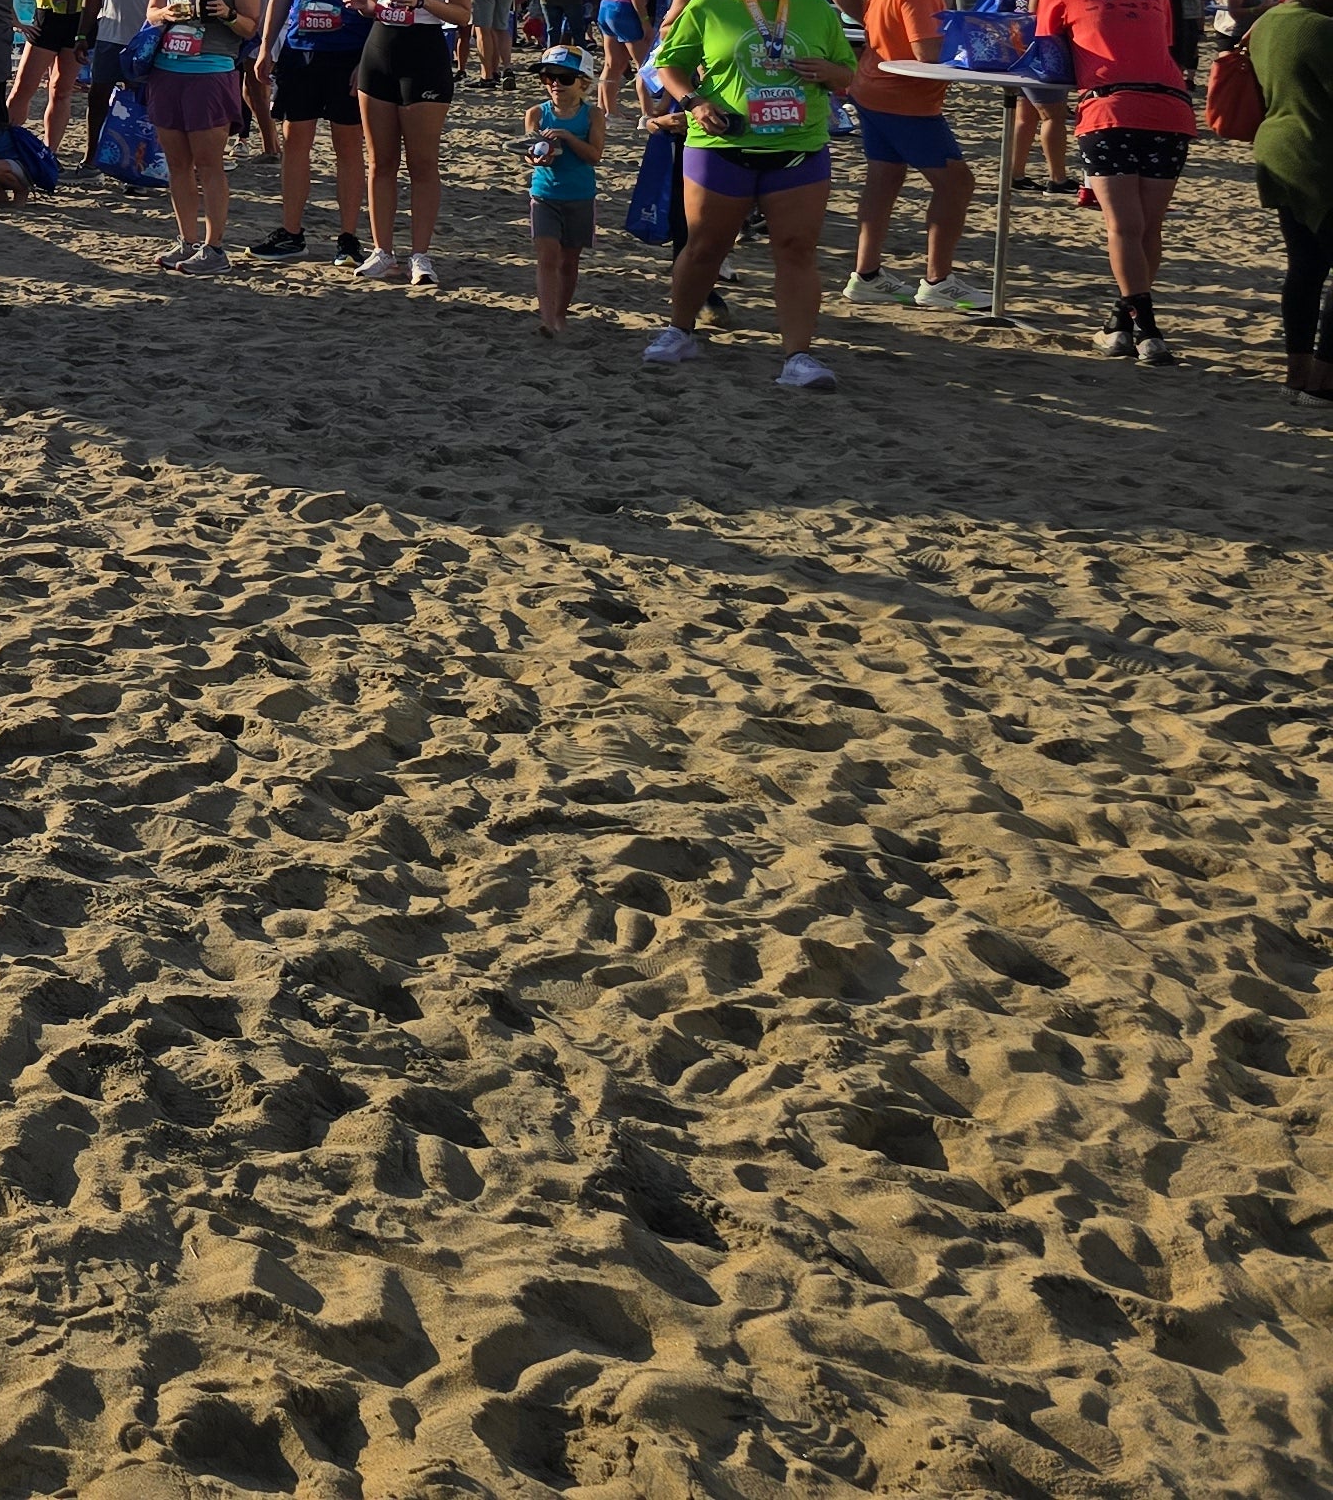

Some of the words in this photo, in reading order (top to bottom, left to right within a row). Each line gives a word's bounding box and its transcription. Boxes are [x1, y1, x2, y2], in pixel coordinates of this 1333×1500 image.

[306, 17, 333, 28] 3058
[168, 39, 192, 52] 4397
[749, 43, 796, 58] SHM
[761, 106, 800, 121] 3954
